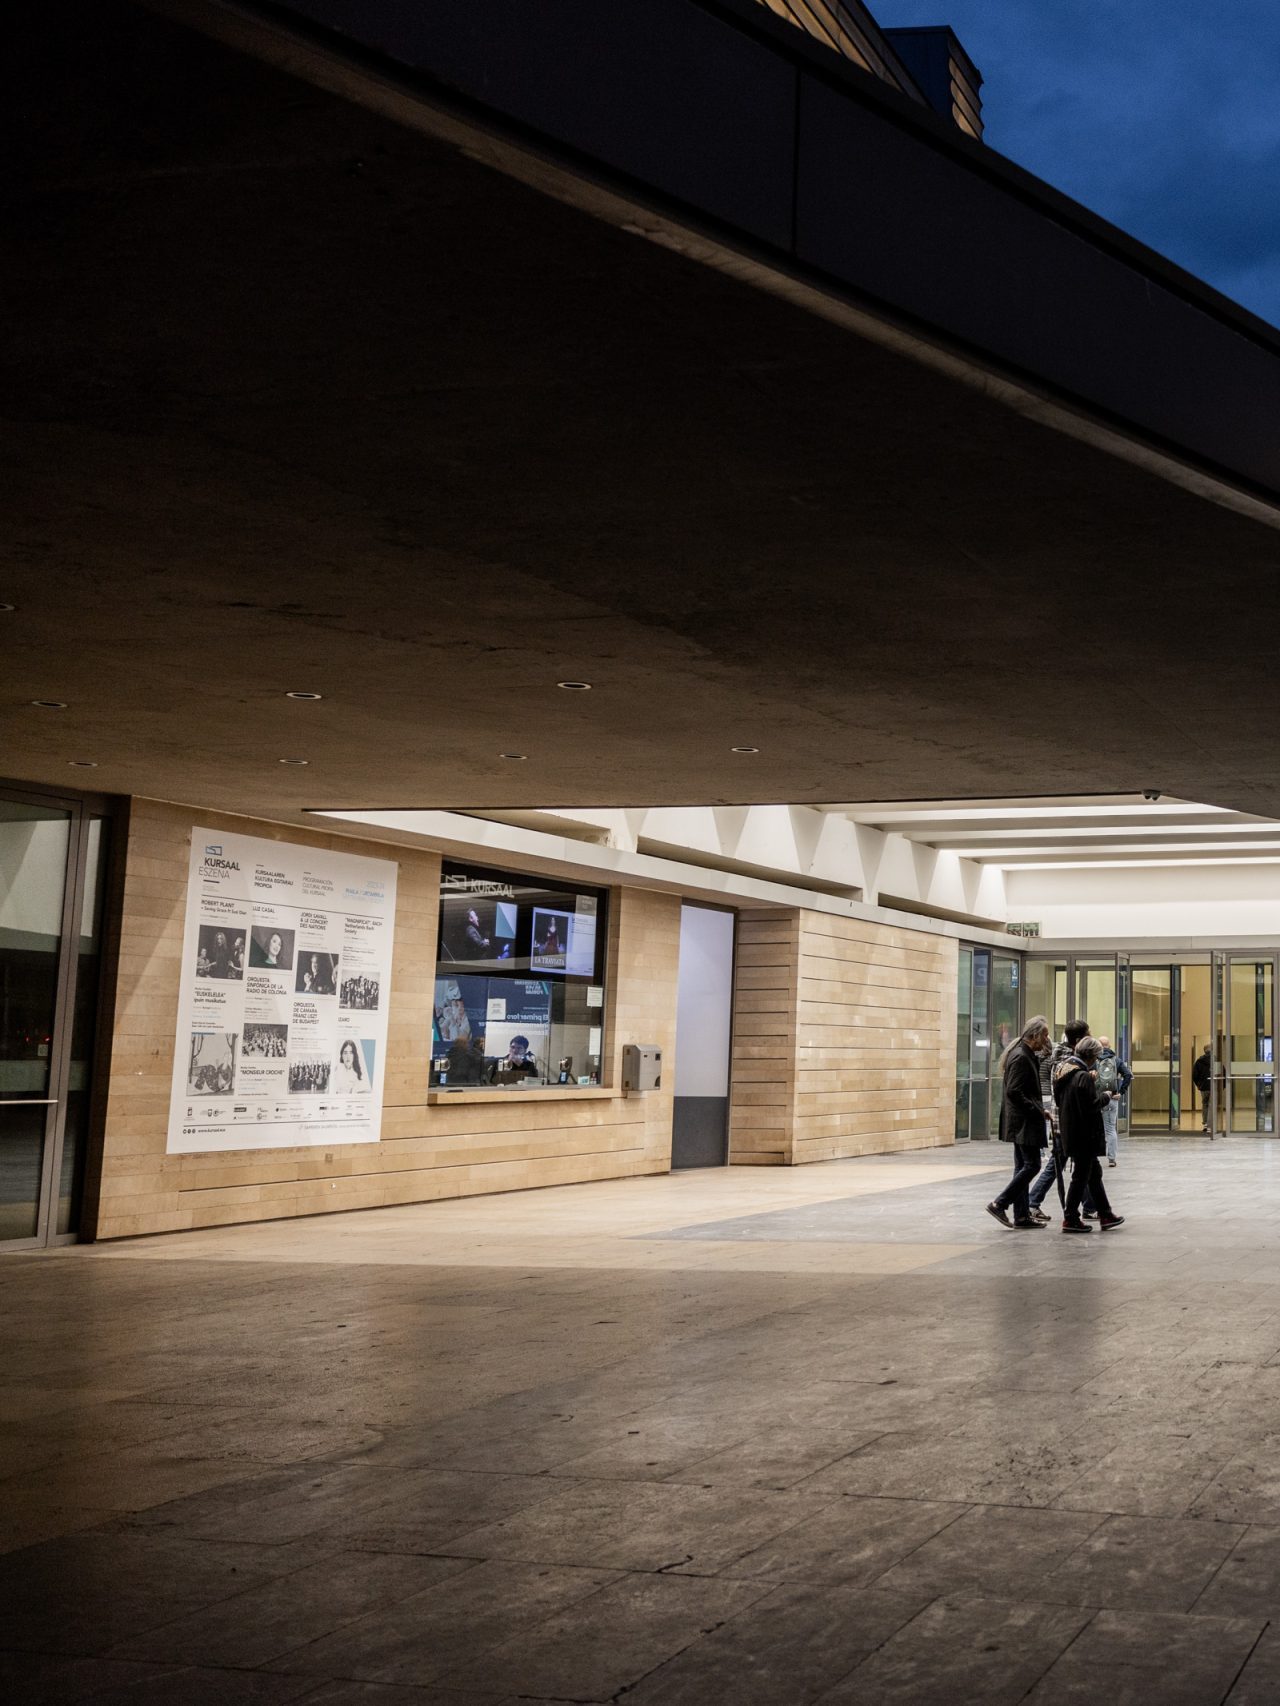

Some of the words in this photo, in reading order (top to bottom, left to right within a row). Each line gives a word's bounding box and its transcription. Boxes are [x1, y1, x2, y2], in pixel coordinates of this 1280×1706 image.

[204, 857, 240, 871] KURSAAL
[199, 866, 231, 879] ESZENA
[255, 870, 285, 878] KURSAALAREN
[470, 878, 515, 898] KURSAAL
